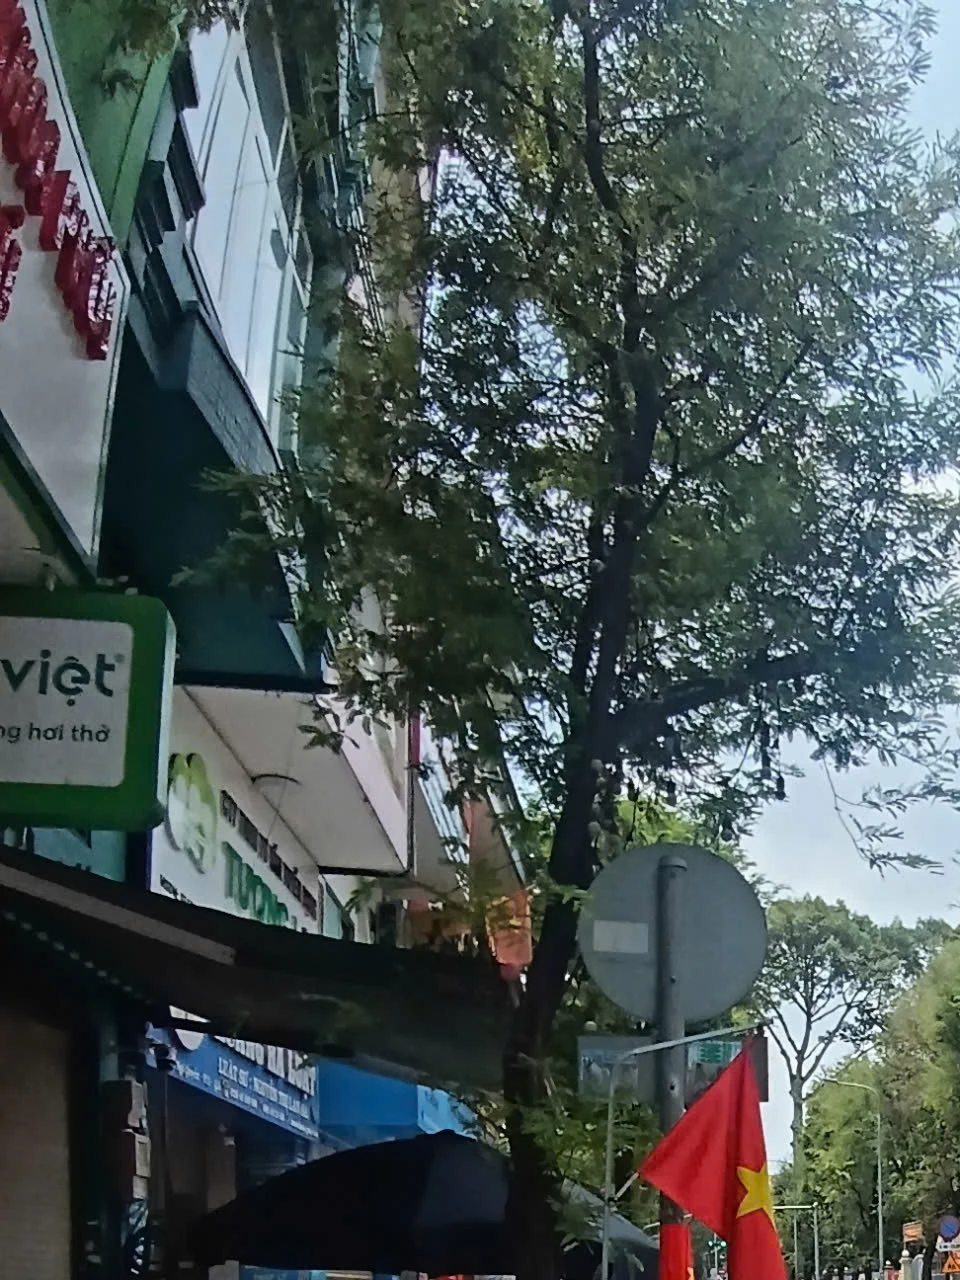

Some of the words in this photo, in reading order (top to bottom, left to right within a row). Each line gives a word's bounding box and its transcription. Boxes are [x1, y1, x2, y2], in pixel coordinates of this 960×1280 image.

[0, 649, 115, 706] việt
[28, 722, 64, 741] hơi
[71, 723, 110, 742] thở
